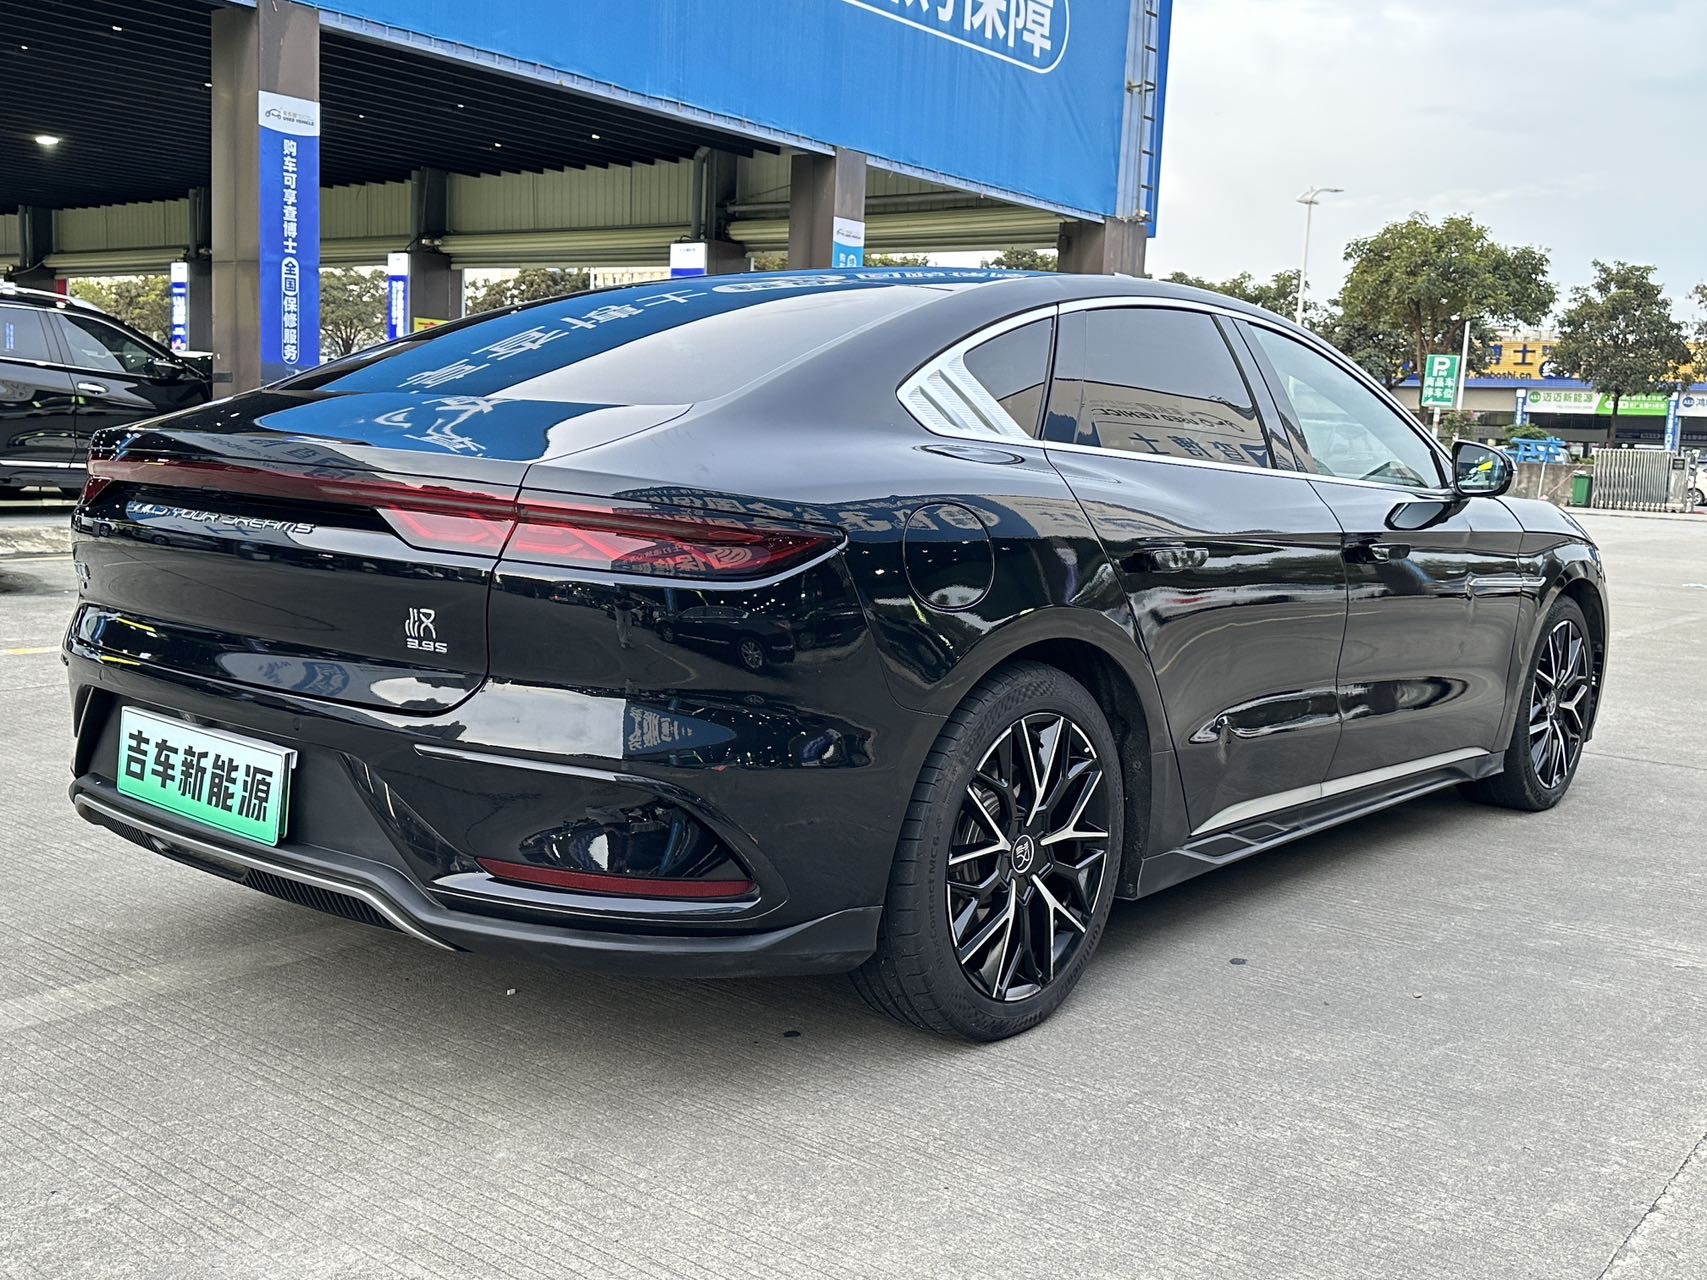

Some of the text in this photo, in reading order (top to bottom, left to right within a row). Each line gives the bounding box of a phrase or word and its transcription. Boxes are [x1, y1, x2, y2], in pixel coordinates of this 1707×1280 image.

[1432, 356, 1451, 376] P
[1424, 376, 1455, 388] 商品车
[1423, 387, 1454, 400] 停车位
[1542, 391, 1593, 403] 迈迈新能源
[172, 507, 220, 524] YOUR
[221, 514, 315, 534] DREAMS
[406, 638, 448, 654] 3.9S
[125, 730, 273, 822] 吉车新能源
